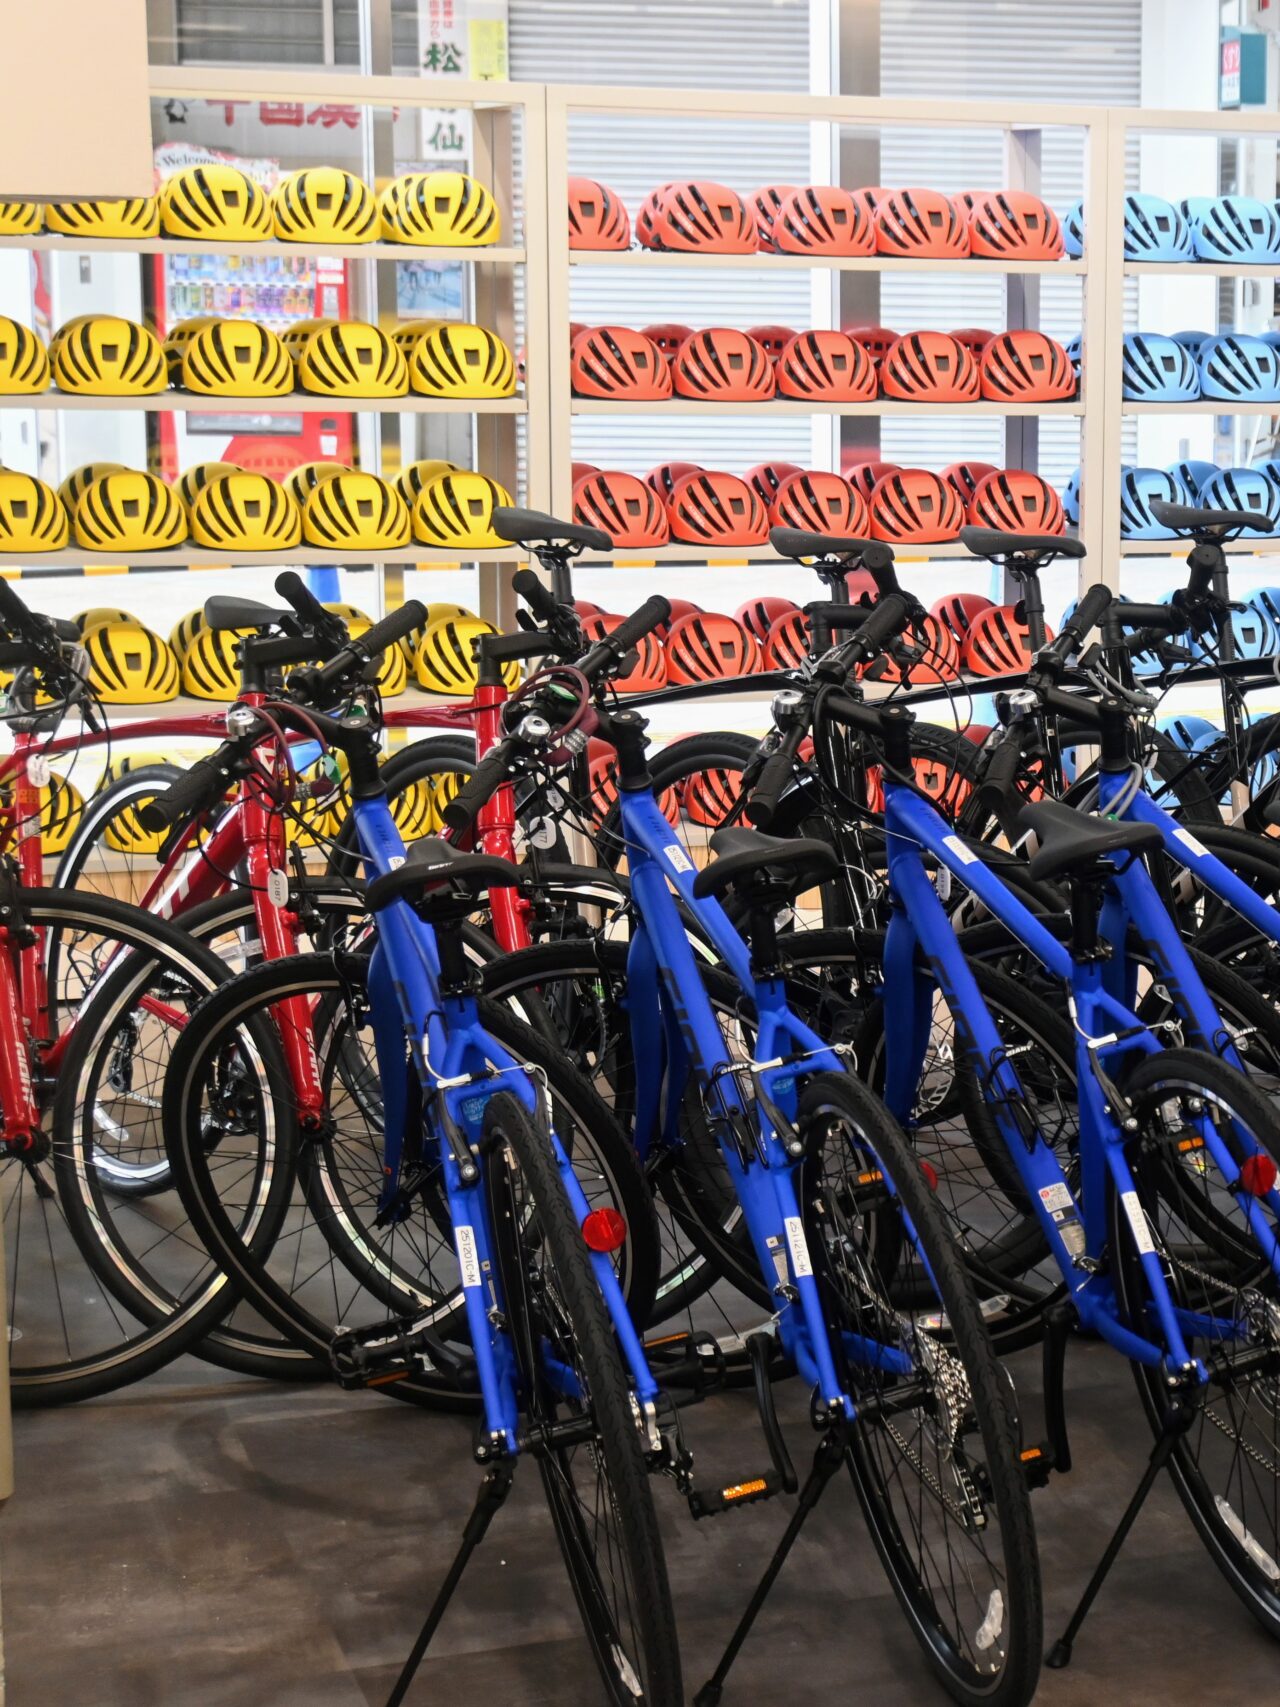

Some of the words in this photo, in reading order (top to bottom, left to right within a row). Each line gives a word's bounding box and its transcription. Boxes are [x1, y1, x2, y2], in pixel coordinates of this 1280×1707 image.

[1233, 1027, 1257, 1038] GIANT
[1006, 1046, 1031, 1057] GIANT
[720, 1063, 748, 1074] GIANT
